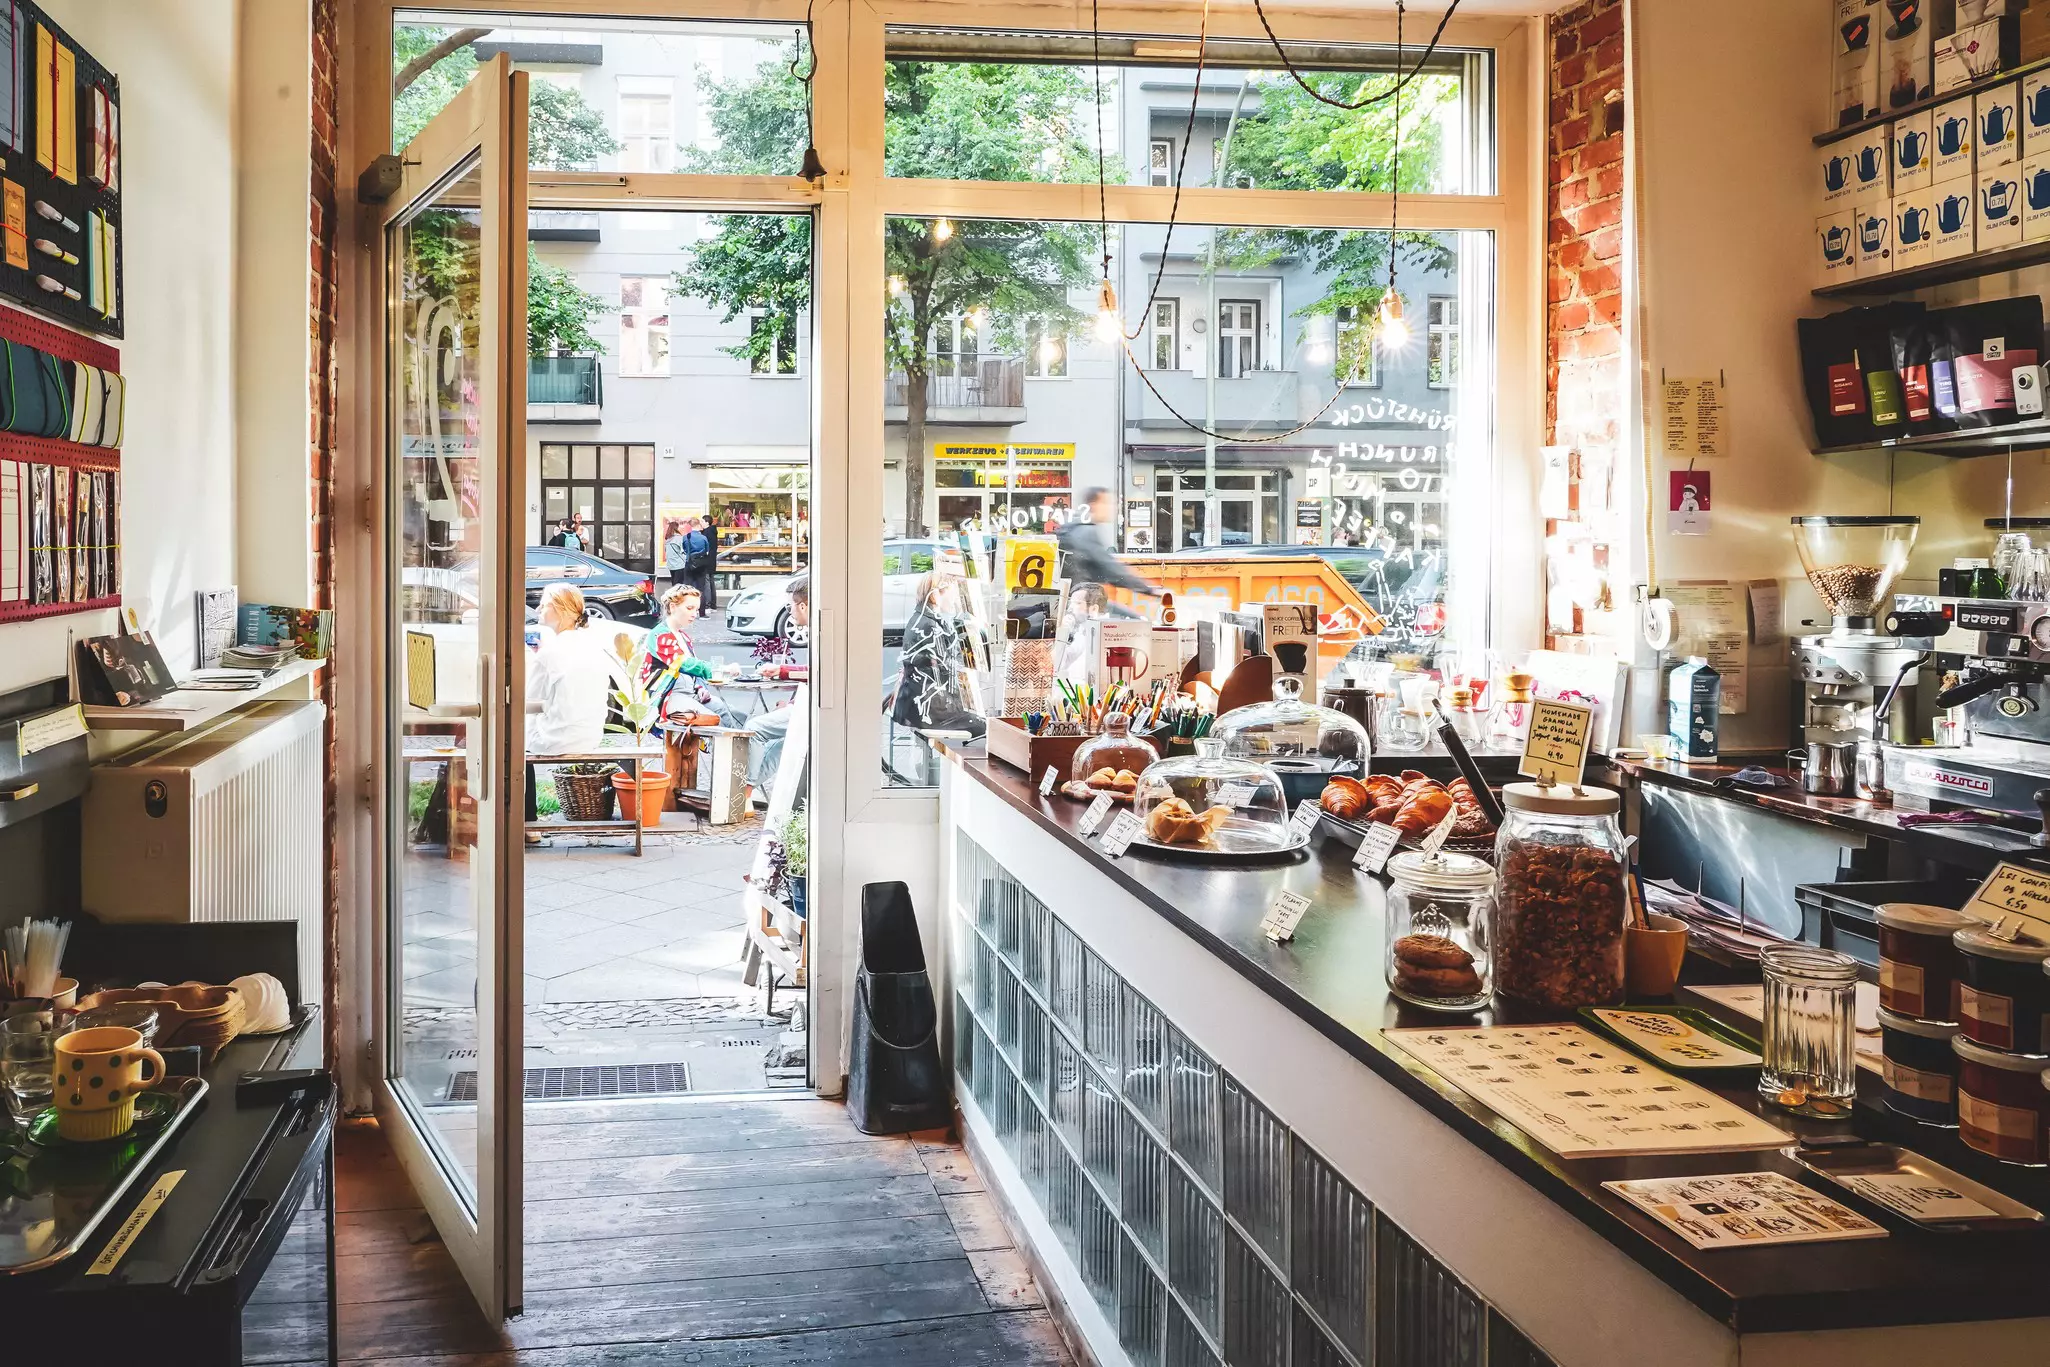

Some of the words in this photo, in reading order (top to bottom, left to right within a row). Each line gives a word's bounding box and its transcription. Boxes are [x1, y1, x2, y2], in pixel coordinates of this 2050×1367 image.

[945, 447, 997, 455] WERKZEUG
[1005, 447, 1065, 456] ESENWAREN
[247, 610, 260, 642] UKÖLLN
